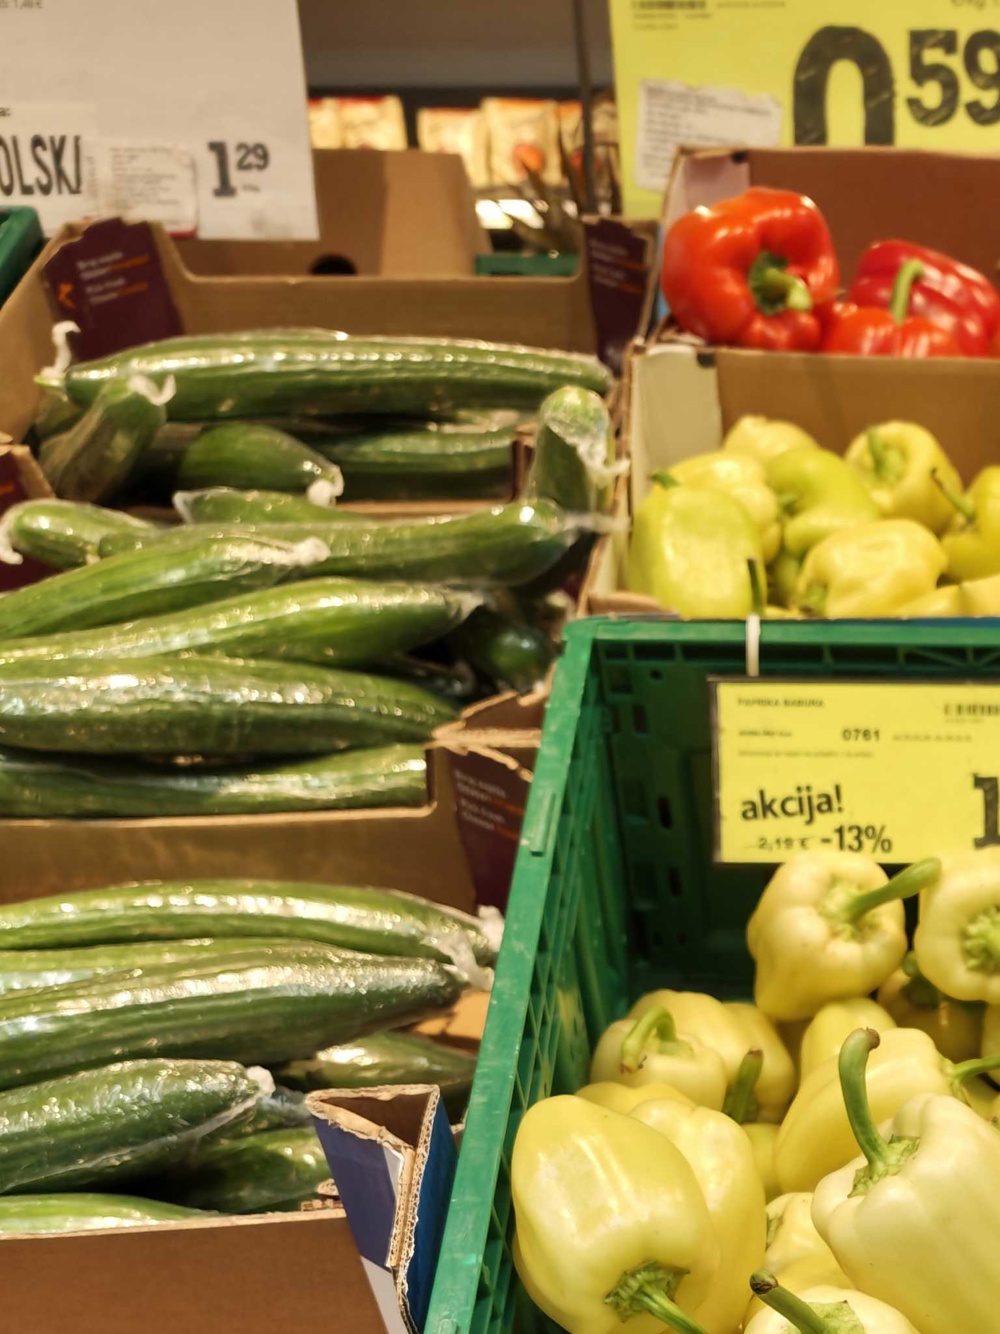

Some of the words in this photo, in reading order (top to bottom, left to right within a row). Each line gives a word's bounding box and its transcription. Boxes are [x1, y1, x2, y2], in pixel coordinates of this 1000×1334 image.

[208, 142, 236, 197] 1
[237, 143, 269, 171] 29
[741, 784, 843, 825] akcija!
[821, 825, 893, 853] -13%
